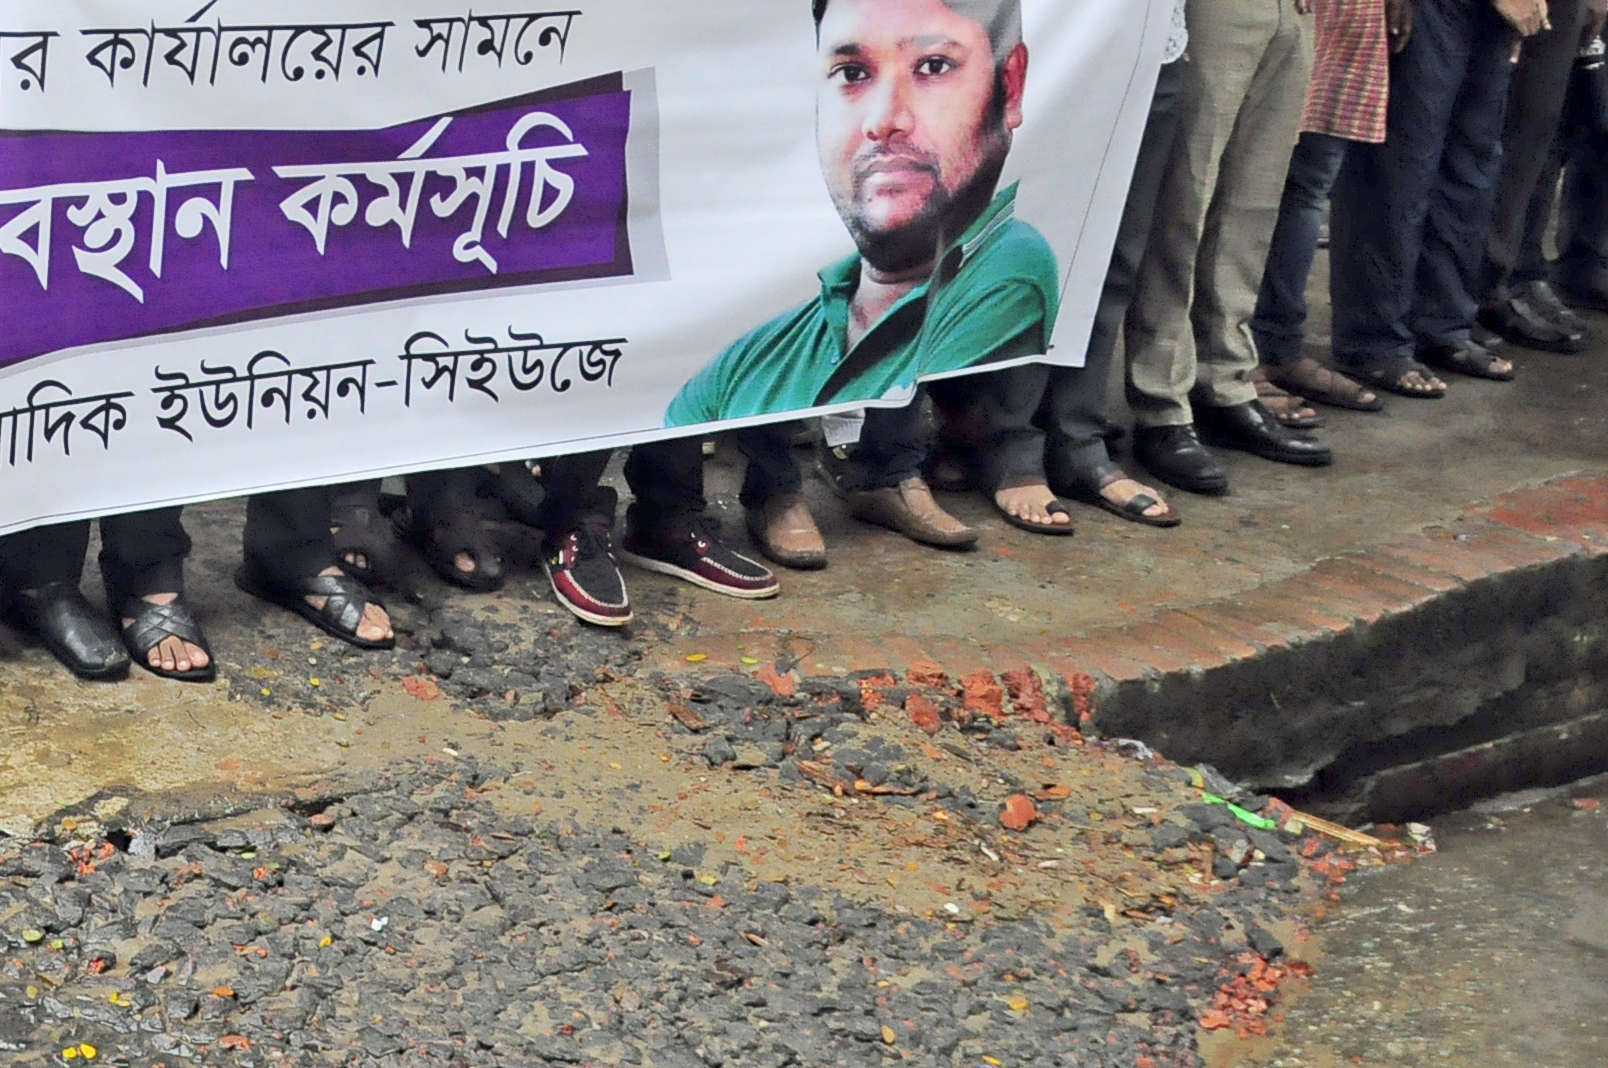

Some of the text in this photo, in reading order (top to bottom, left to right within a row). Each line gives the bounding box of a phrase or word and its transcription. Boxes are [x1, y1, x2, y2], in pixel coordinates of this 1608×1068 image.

[80, 0, 396, 88] কার্যালয়ের
[413, 9, 583, 73] সামনে
[276, 112, 588, 274] কর্মসূচি
